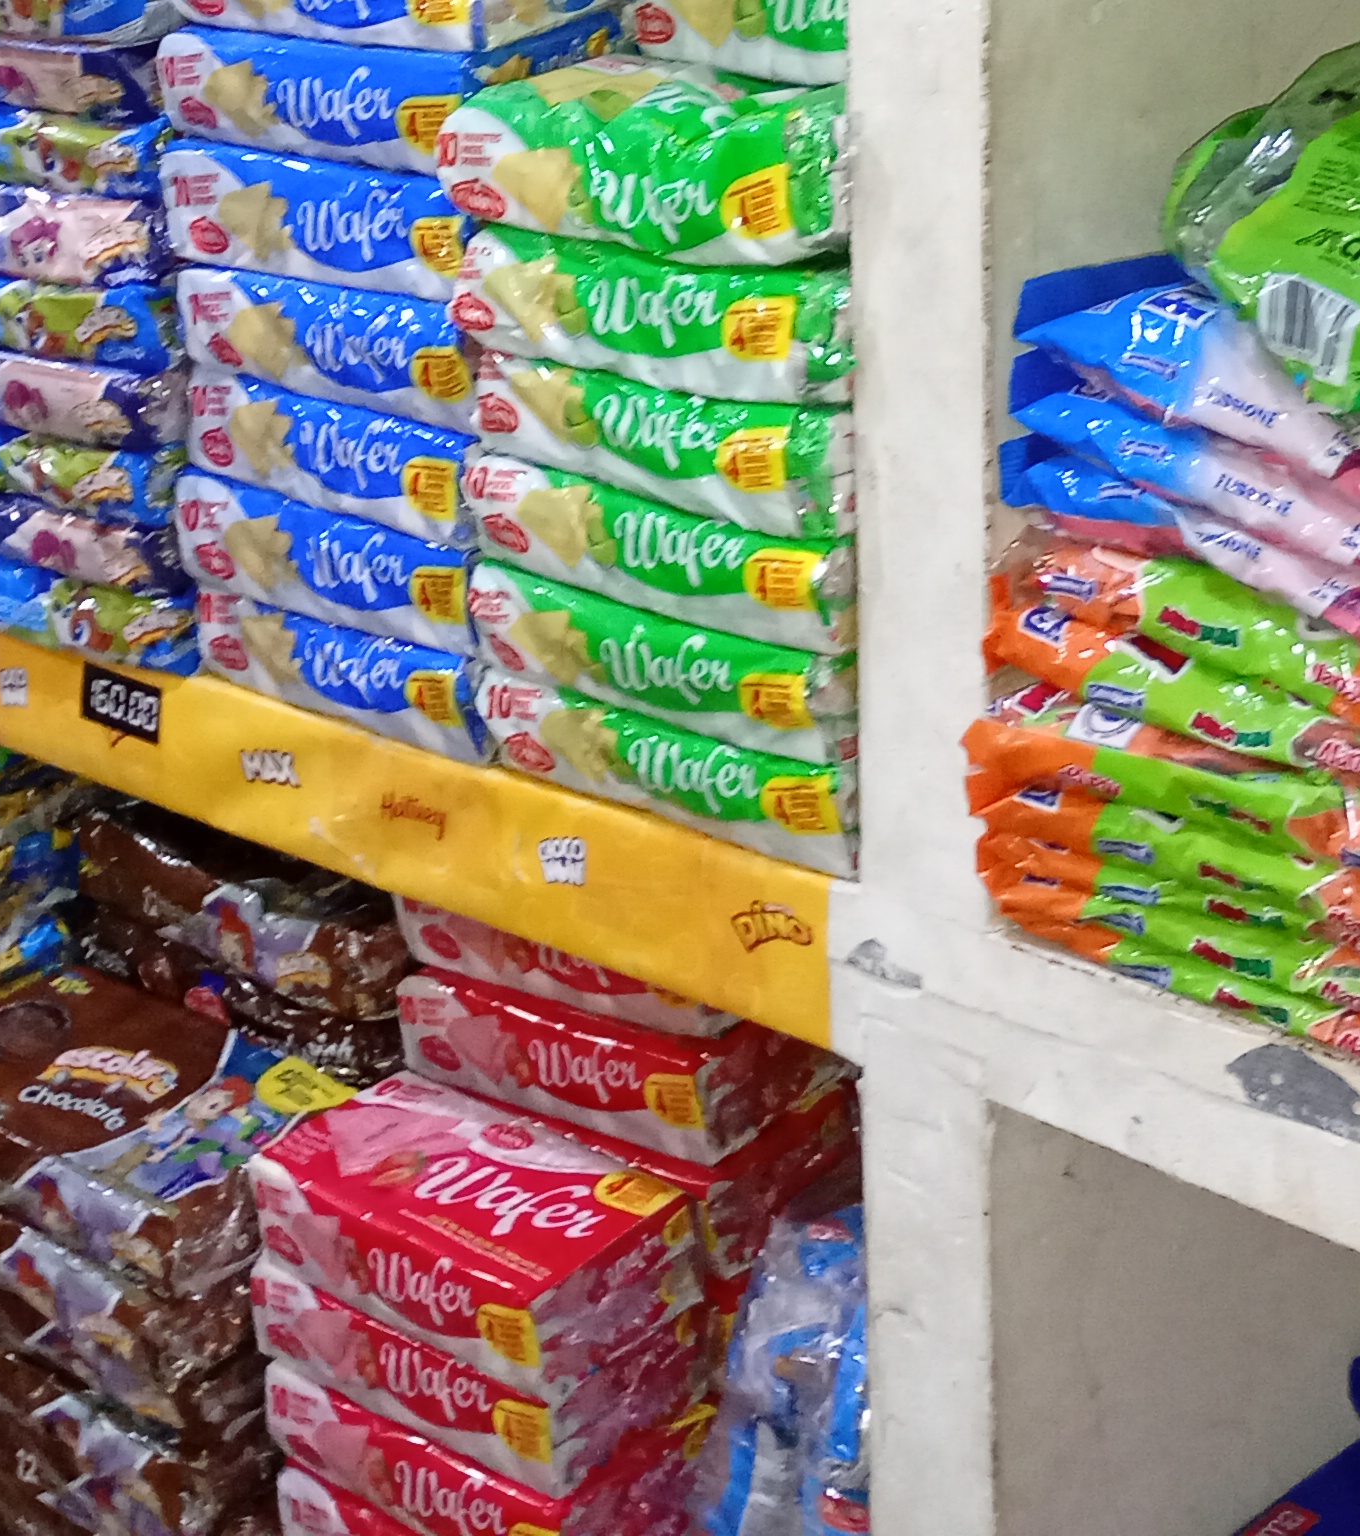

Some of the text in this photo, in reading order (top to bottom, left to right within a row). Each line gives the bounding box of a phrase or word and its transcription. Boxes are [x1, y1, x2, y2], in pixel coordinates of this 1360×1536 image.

[277, 66, 395, 139] Wafer
[298, 190, 410, 261] Wafer
[306, 314, 411, 383] Wafer
[589, 276, 722, 348] Wafer
[300, 417, 401, 490] Wafer
[594, 392, 722, 471] Wafer
[307, 532, 409, 602] Wafer
[614, 511, 748, 587] Wafer
[599, 628, 733, 703] Wafer
[629, 736, 759, 813] Wafer
[527, 1038, 642, 1103] Wafer
[414, 1156, 607, 1238] Wafer
[367, 1248, 479, 1325] Wafer
[379, 1342, 494, 1421] Wafer
[394, 1460, 506, 1536] Wafer
